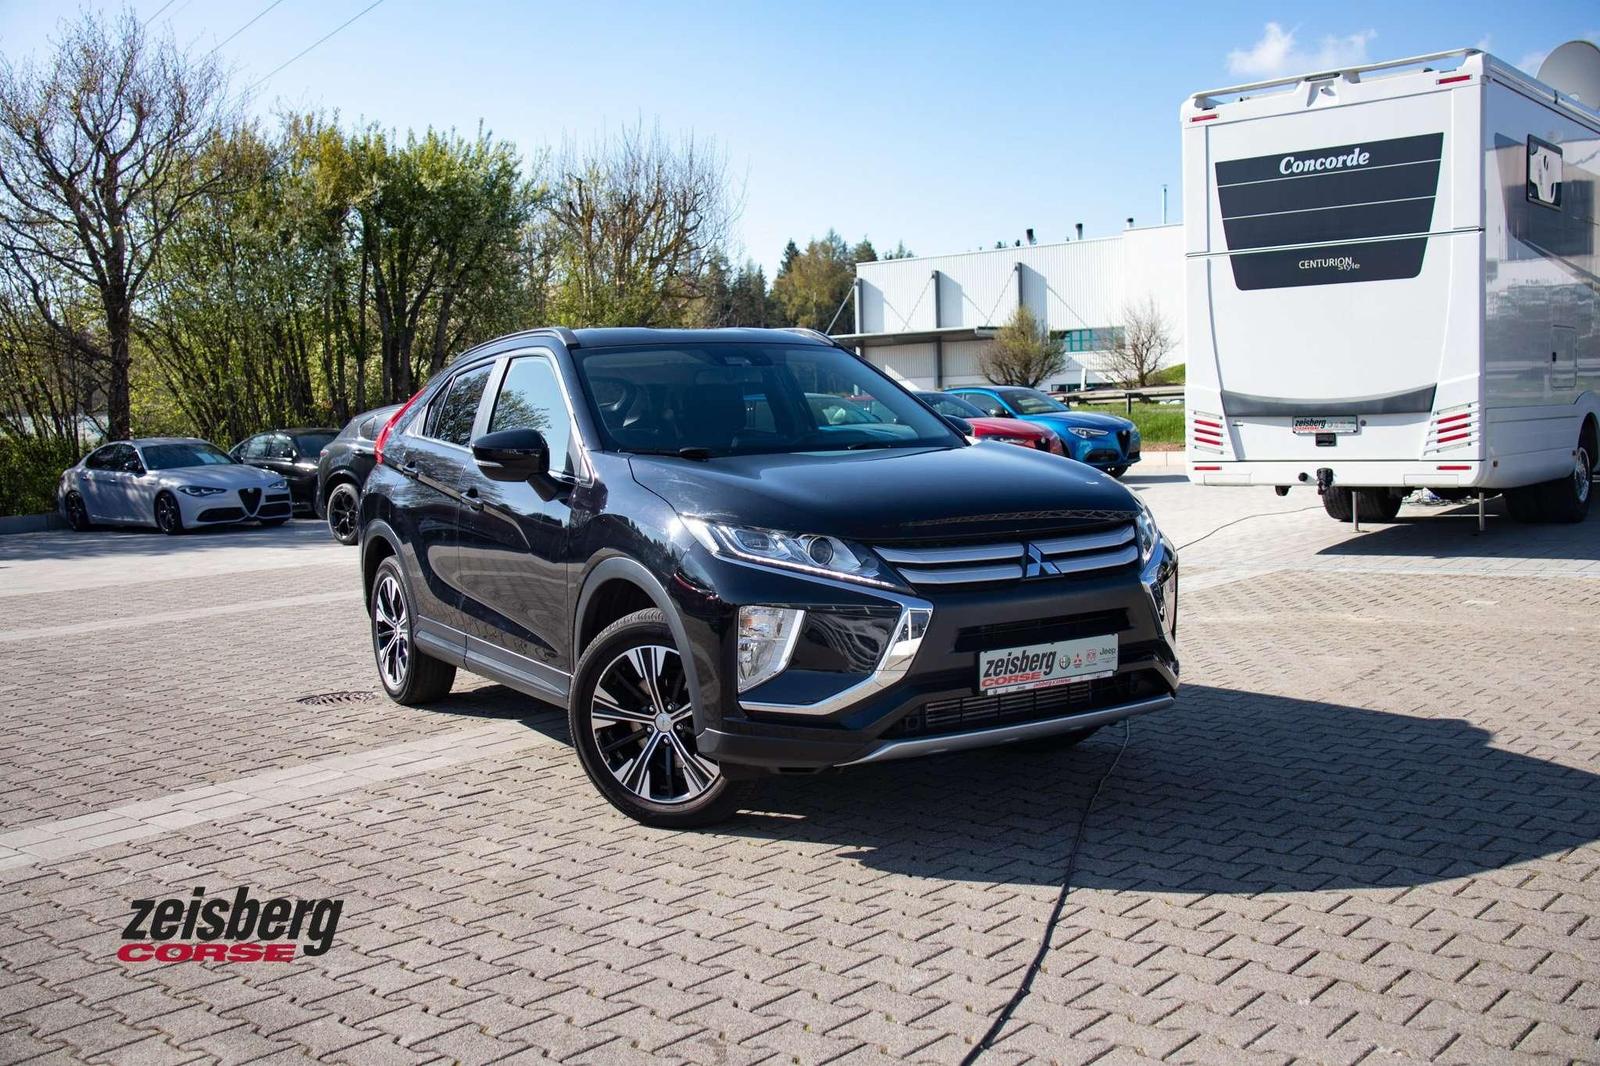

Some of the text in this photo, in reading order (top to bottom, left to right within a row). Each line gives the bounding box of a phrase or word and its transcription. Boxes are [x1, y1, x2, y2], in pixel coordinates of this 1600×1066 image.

[1280, 148, 1370, 175] Concorde
[1298, 257, 1353, 269] CENTURION
[1295, 418, 1327, 428] zeisberg
[1099, 647, 1116, 656] Jeep
[983, 650, 1057, 676] zeisberg
[981, 672, 1042, 687] CORSE
